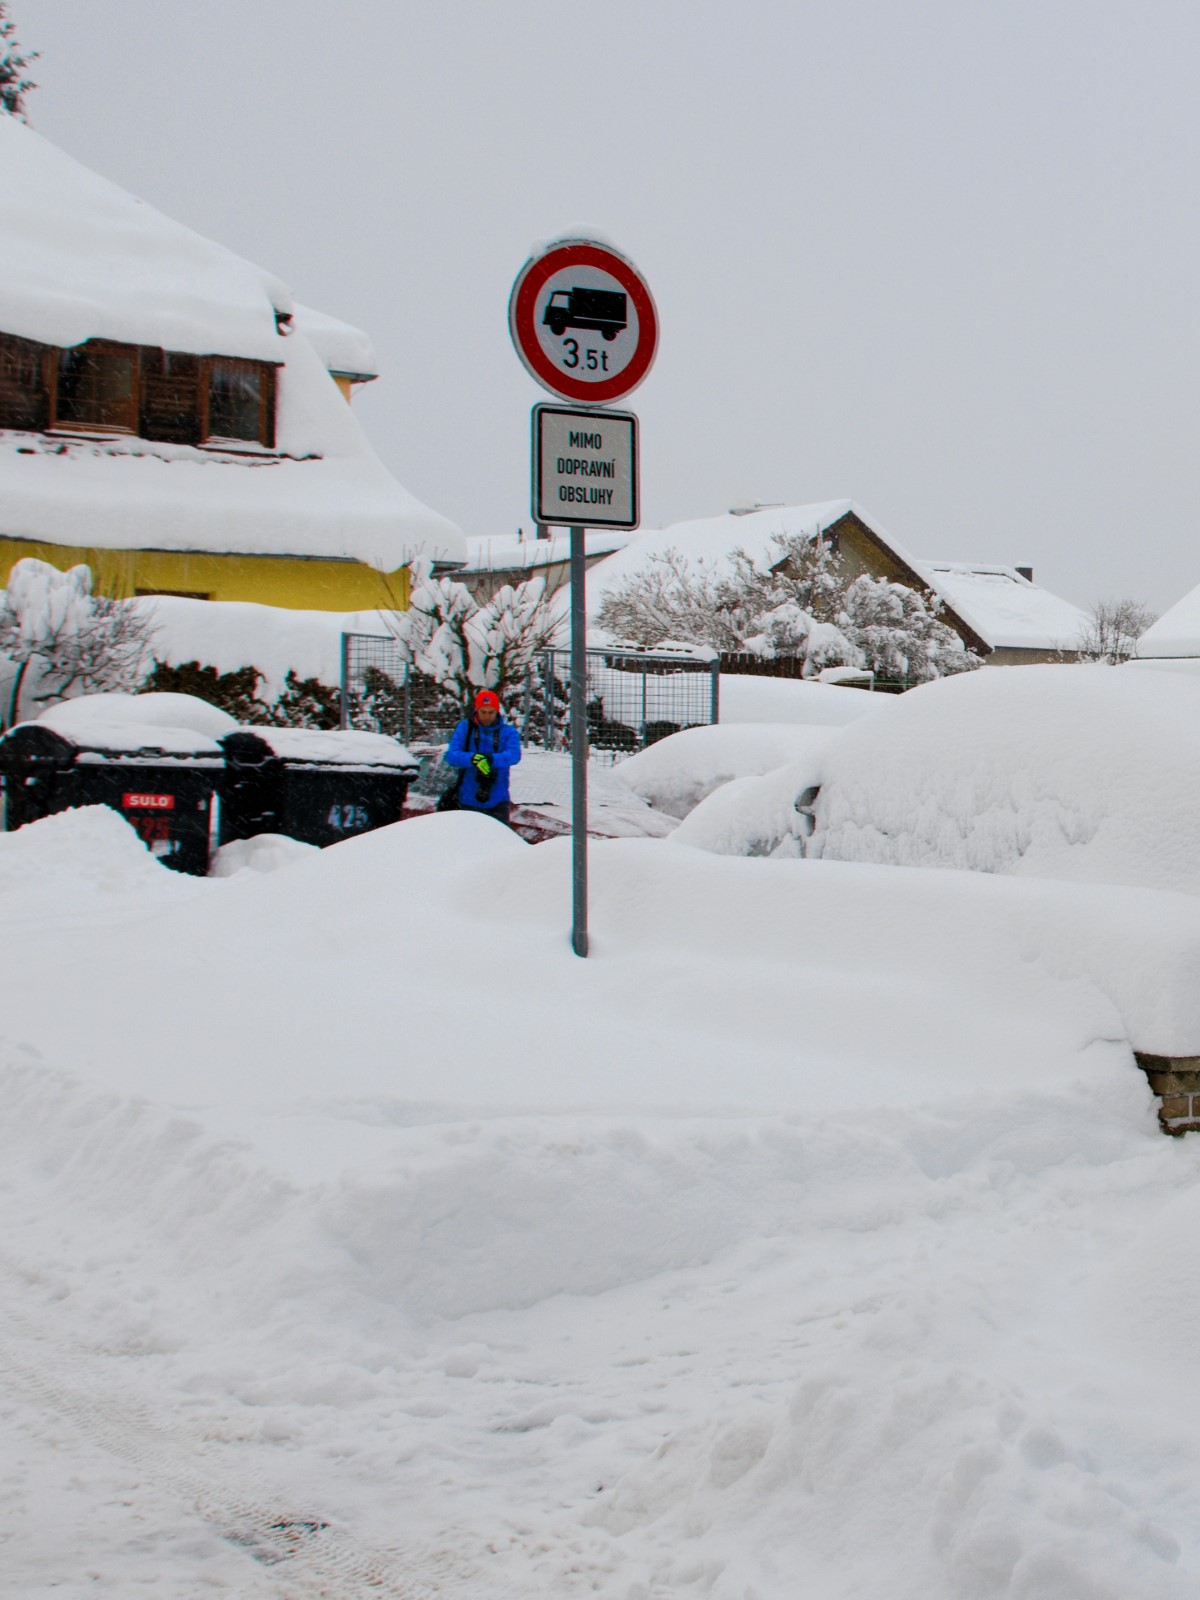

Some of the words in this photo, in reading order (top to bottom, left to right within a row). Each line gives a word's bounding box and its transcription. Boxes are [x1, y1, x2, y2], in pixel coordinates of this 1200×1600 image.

[568, 431, 602, 449] MIMO
[557, 457, 616, 479] DOPRAVNÍ
[559, 485, 613, 505] OBSLUHY
[129, 795, 169, 807] SULO
[327, 804, 369, 828] 425
